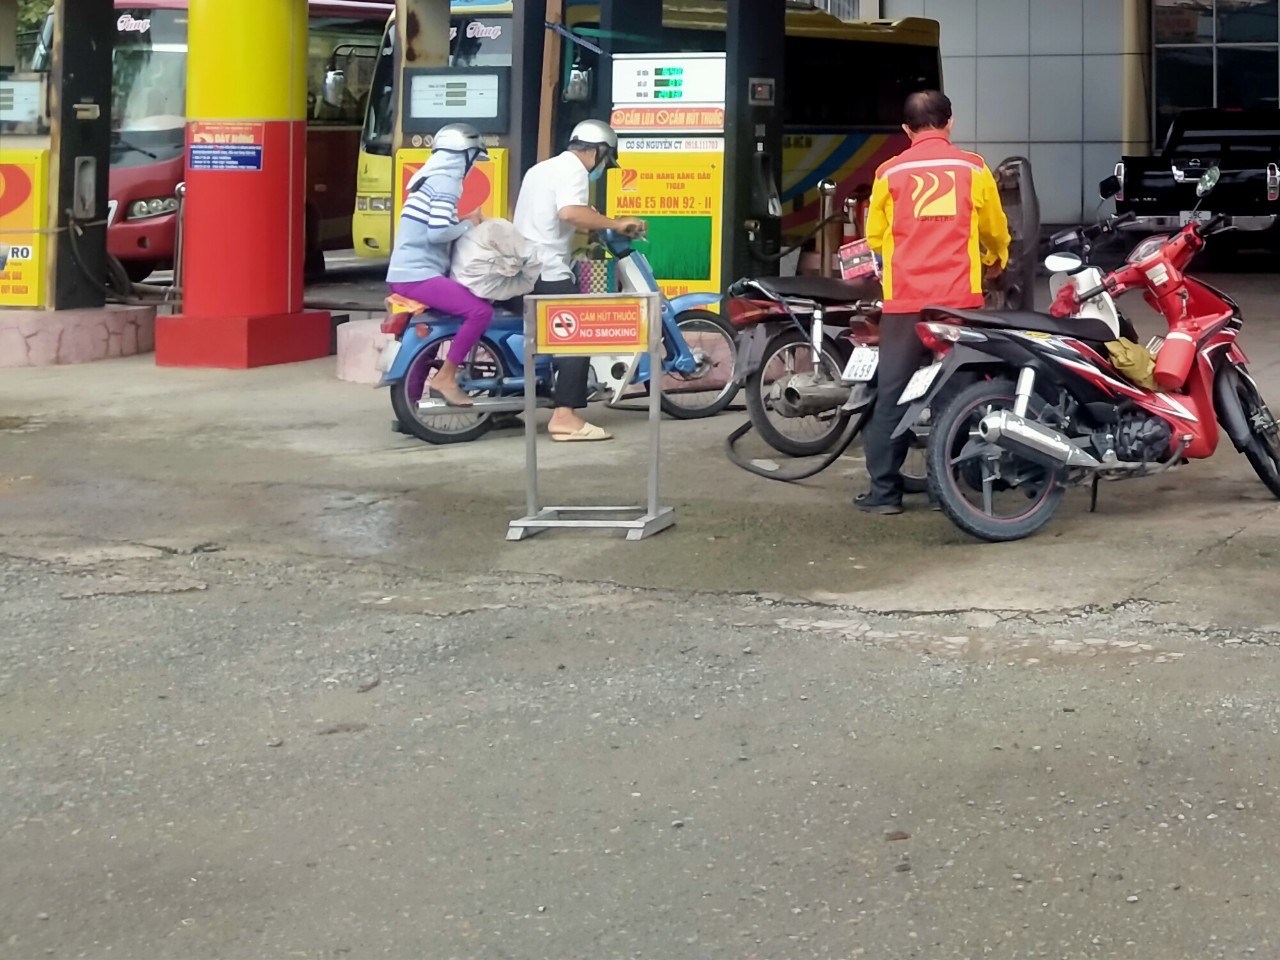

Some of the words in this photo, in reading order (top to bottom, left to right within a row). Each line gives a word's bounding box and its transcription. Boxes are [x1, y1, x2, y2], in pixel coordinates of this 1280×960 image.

[645, 196, 656, 208] E5
[660, 196, 679, 208] RON
[683, 196, 695, 208] 92
[580, 328, 593, 338] NO
[595, 328, 637, 338] SMOKING
